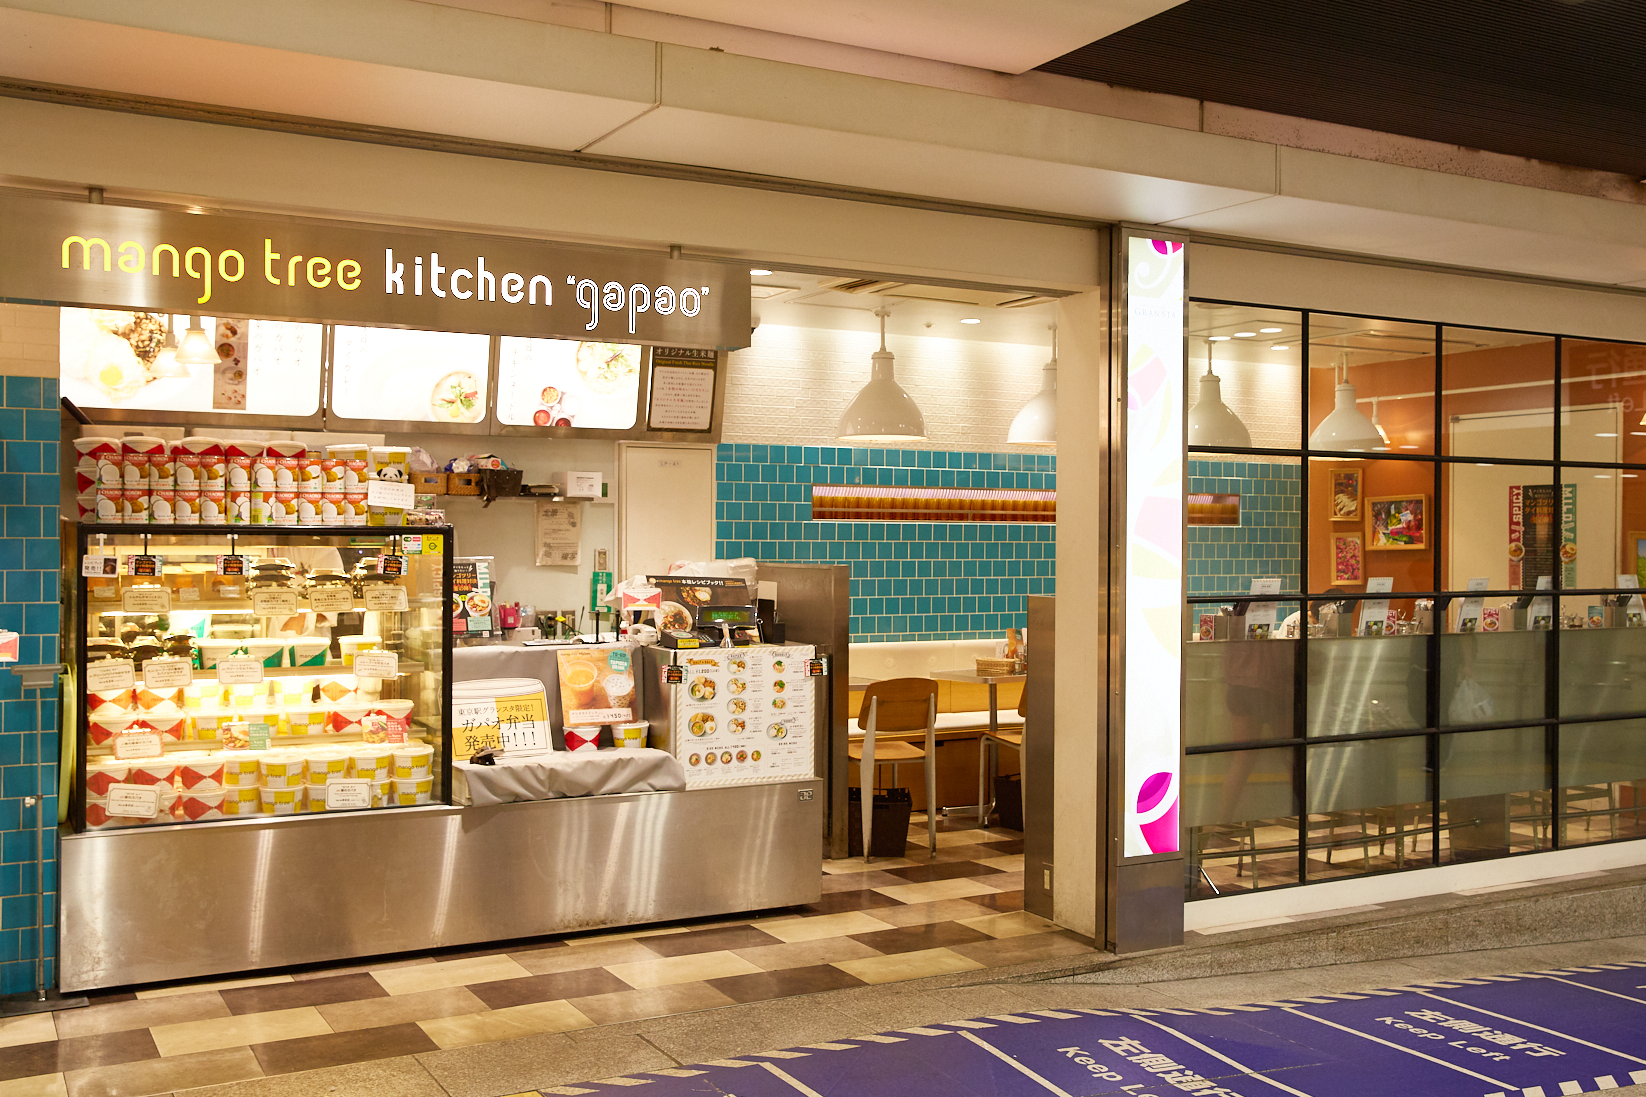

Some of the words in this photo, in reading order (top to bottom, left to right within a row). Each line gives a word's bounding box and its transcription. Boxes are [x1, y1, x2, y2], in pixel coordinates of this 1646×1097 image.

[61, 235, 246, 304] mango
[264, 238, 362, 291] tree
[385, 248, 553, 306] kitchen
[1512, 488, 1523, 523] SPICY
[1563, 487, 1573, 522] MILD
[458, 704, 535, 716] 東京駅グランスタ限定!
[462, 714, 535, 733] ガパオ弁当
[465, 731, 536, 752] 発売中!!!
[1374, 1016, 1446, 1041] Keep
[1447, 1040, 1512, 1062] Left
[1403, 1008, 1567, 1058] 左側通行
[1056, 1046, 1123, 1082] Keep
